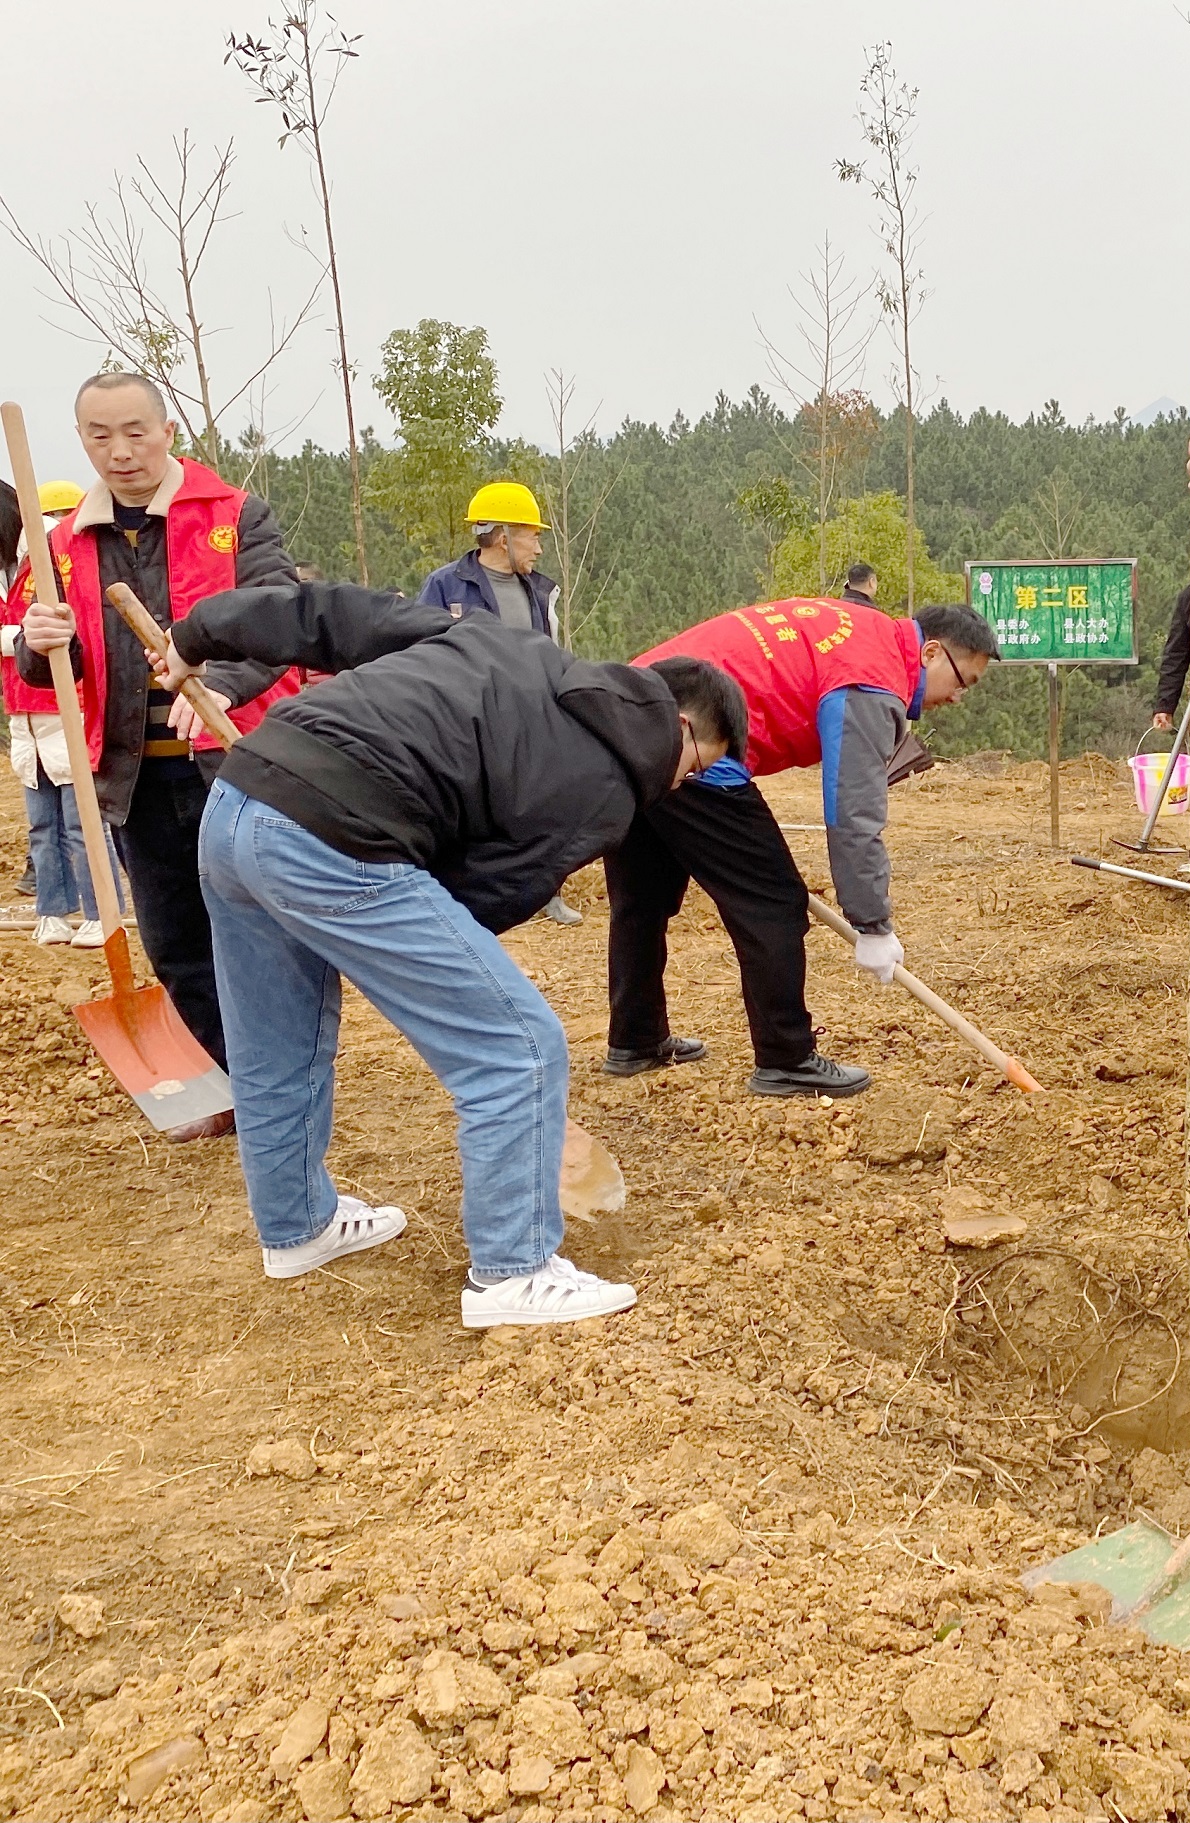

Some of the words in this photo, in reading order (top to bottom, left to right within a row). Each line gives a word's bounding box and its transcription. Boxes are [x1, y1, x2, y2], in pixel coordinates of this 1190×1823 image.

[1014, 585, 1090, 610] 第二区
[996, 618, 1030, 631] 县委办
[1063, 617, 1109, 630] 县人大办
[997, 632, 1042, 645] 县政府办
[1063, 632, 1110, 645] 县政协办
